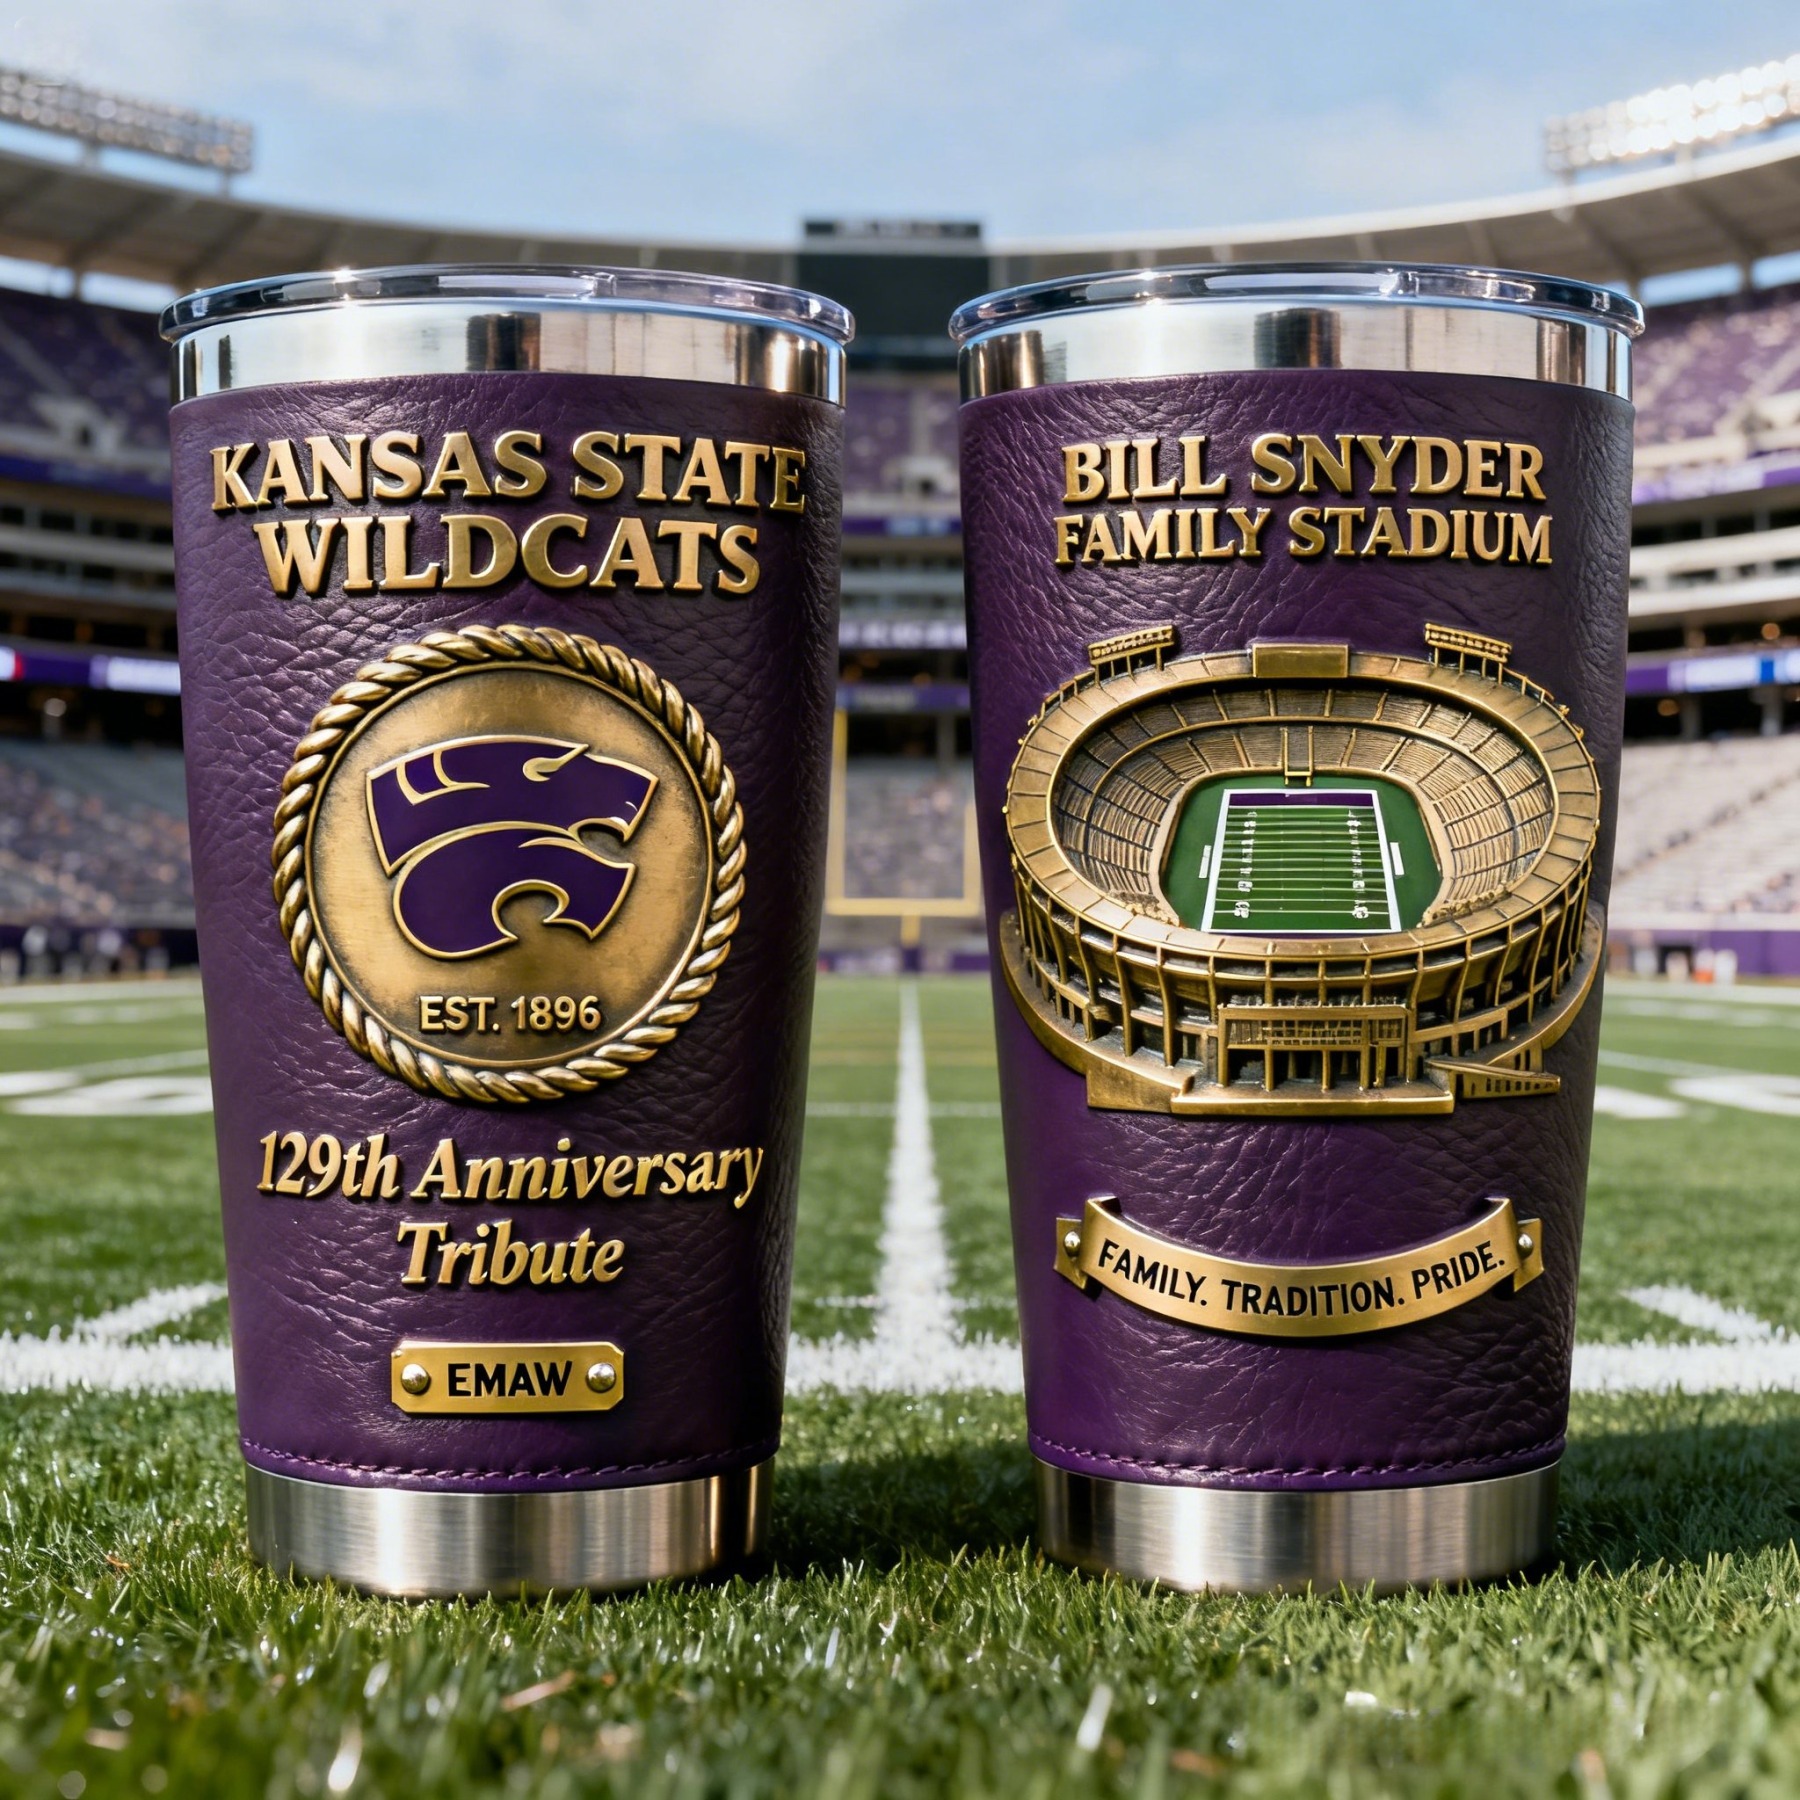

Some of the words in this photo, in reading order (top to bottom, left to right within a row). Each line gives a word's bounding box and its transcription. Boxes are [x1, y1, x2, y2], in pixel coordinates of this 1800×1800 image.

[211, 431, 547, 511] KANSAS
[573, 431, 806, 514] STATE
[1062, 435, 1226, 502] BILL
[1251, 433, 1546, 499] SNYDER
[253, 514, 758, 597] WILDCATS
[1054, 507, 1271, 565] FAMILY
[1287, 506, 1553, 564] STADIUM
[419, 995, 500, 1032] EST.
[510, 995, 601, 1032] 1896
[257, 1130, 400, 1199] 129th
[411, 1138, 764, 1208] Anniversary
[397, 1218, 626, 1286] Tribute
[1098, 1238, 1208, 1306] FAMILY.
[1221, 1276, 1405, 1317] TRADITION.
[1411, 1240, 1505, 1300] PRIDE.
[447, 1361, 573, 1397] EMAW
